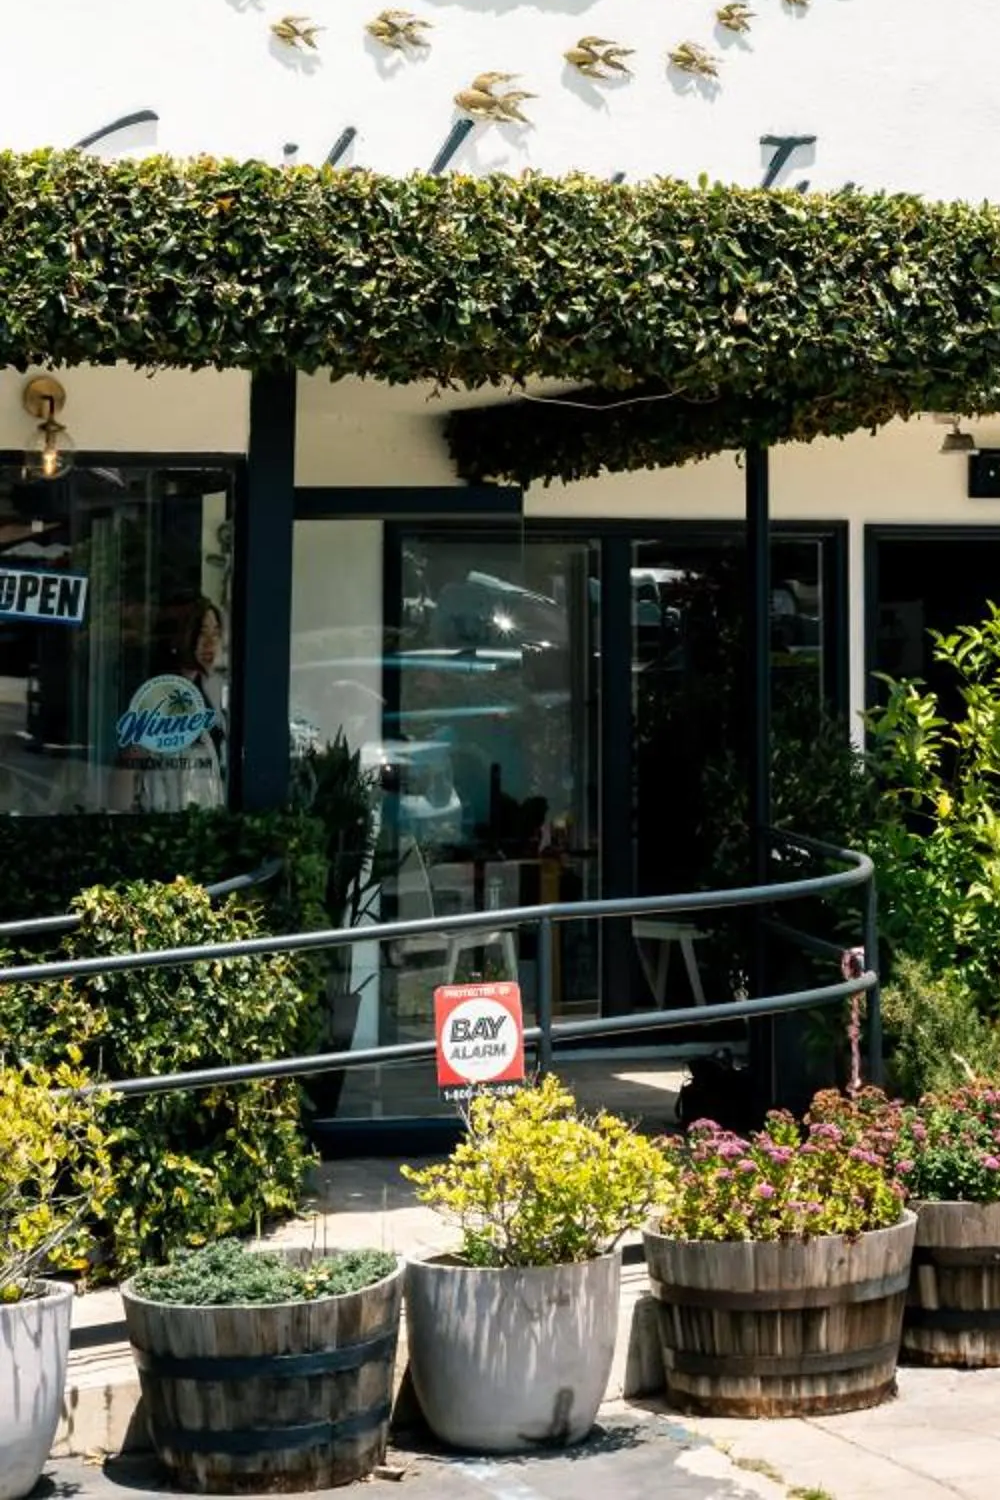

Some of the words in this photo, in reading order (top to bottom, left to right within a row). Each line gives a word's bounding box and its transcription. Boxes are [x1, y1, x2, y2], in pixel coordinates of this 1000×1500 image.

[0, 576, 82, 617] OPEN
[118, 709, 215, 744] Winner
[157, 736, 186, 748] 2021
[450, 1015, 507, 1043] BAY
[450, 1043, 507, 1060] ALARM
